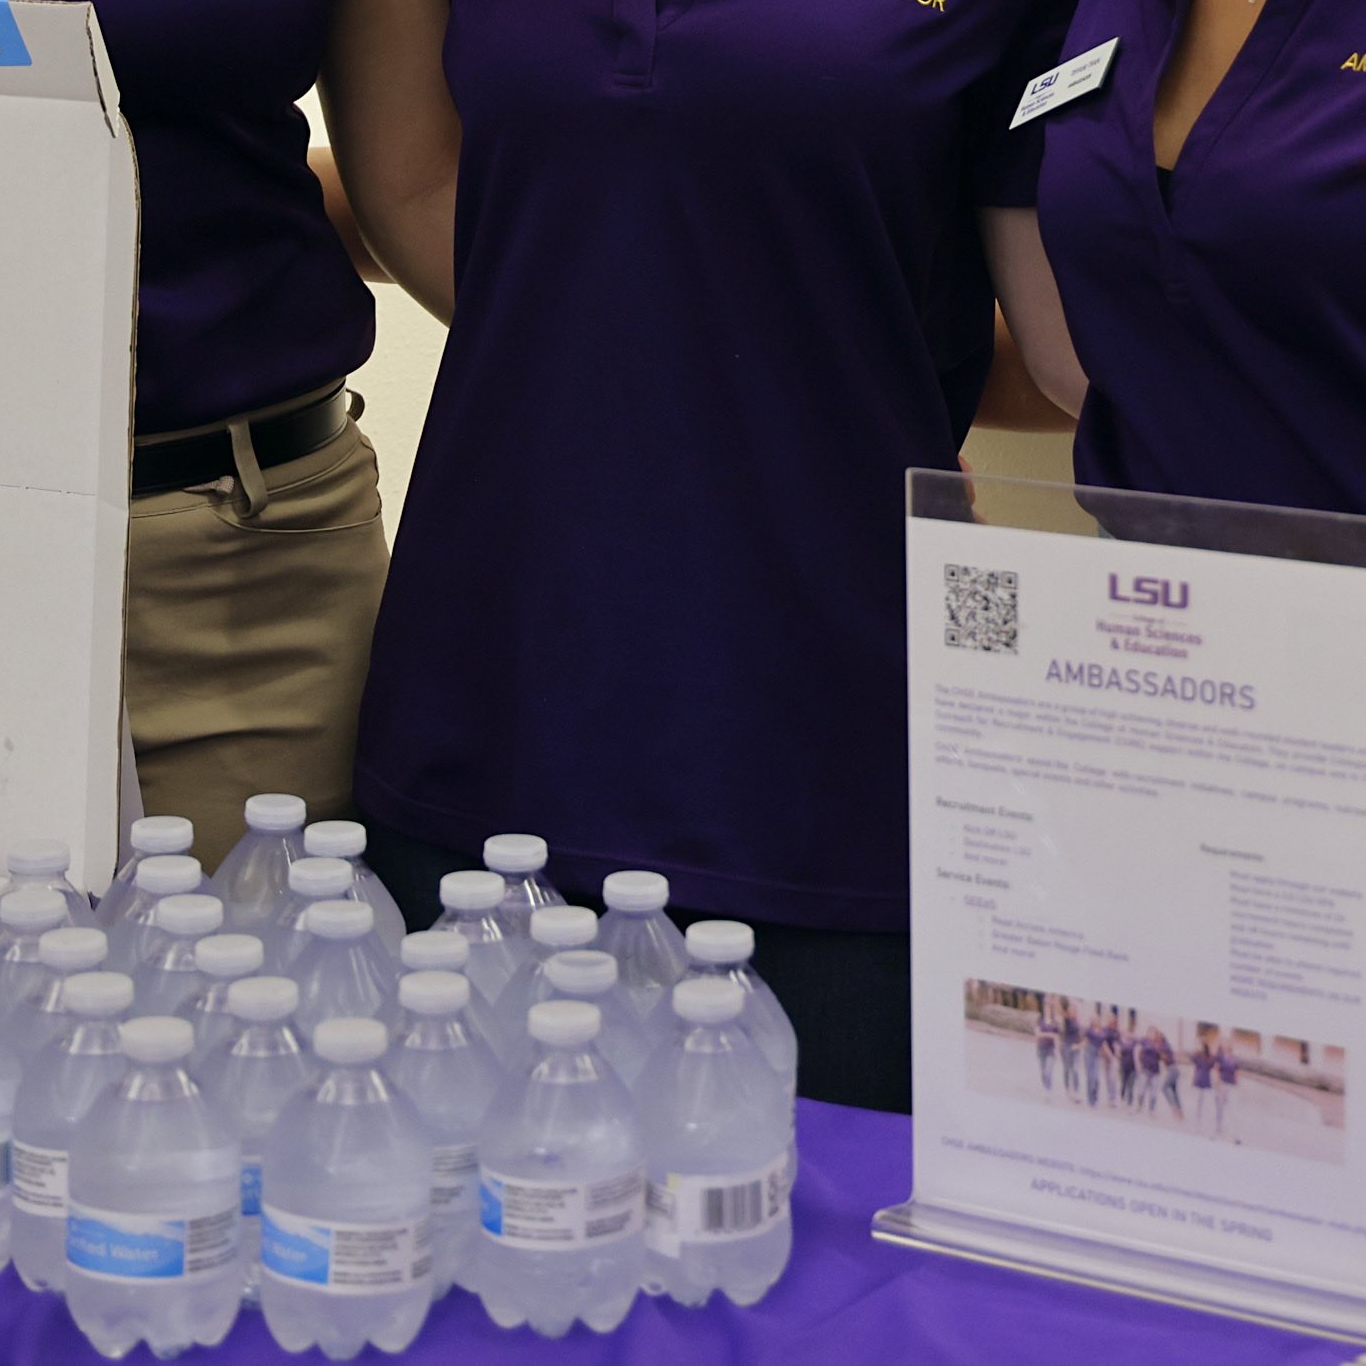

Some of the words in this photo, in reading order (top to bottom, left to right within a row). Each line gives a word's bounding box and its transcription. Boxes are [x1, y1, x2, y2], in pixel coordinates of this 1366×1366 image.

[1030, 71, 1060, 95] LSU
[1108, 572, 1189, 609] LSU
[1045, 659, 1256, 711] AMBASSADORS
